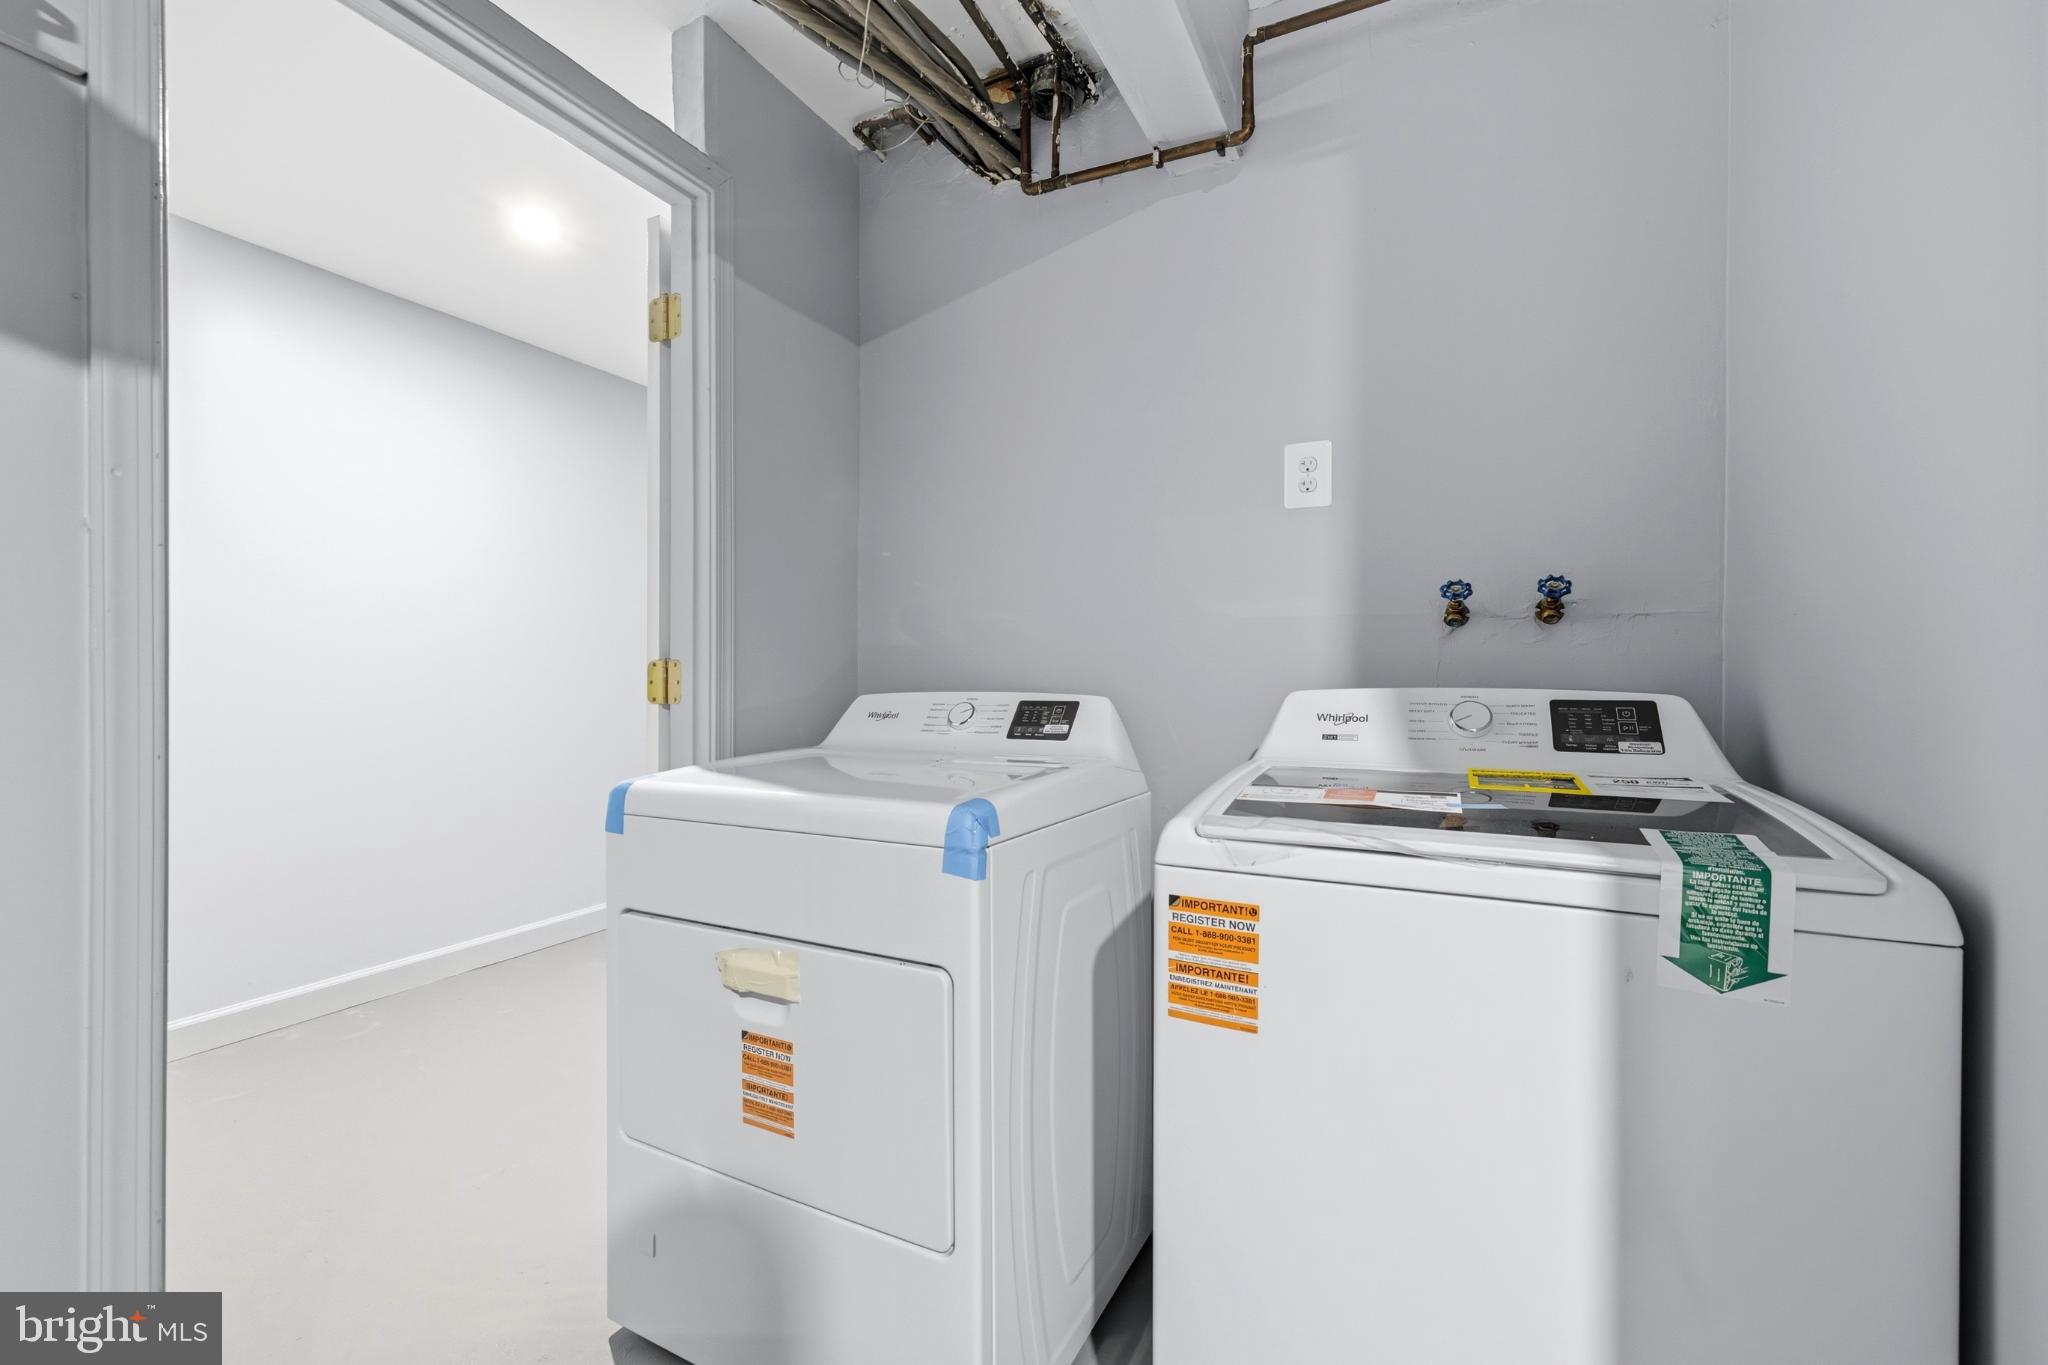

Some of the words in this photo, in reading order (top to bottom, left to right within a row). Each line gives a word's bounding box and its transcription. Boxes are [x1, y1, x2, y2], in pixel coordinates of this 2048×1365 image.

[867, 710, 899, 722] Whirlpool
[1317, 713, 1369, 726] Whirlpool
[1692, 871, 1761, 886] IMPORTANTE
[1181, 898, 1248, 916] IMPORTANT!
[1172, 912, 1226, 928] REGISTER
[1229, 920, 1256, 932] NOW
[1171, 925, 1193, 936] CALL
[1195, 929, 1256, 945] 1-888-900-3381
[1175, 964, 1249, 984] IMPORTANTE!
[743, 1044, 774, 1058] REGISTER
[776, 1052, 791, 1062] NOW
